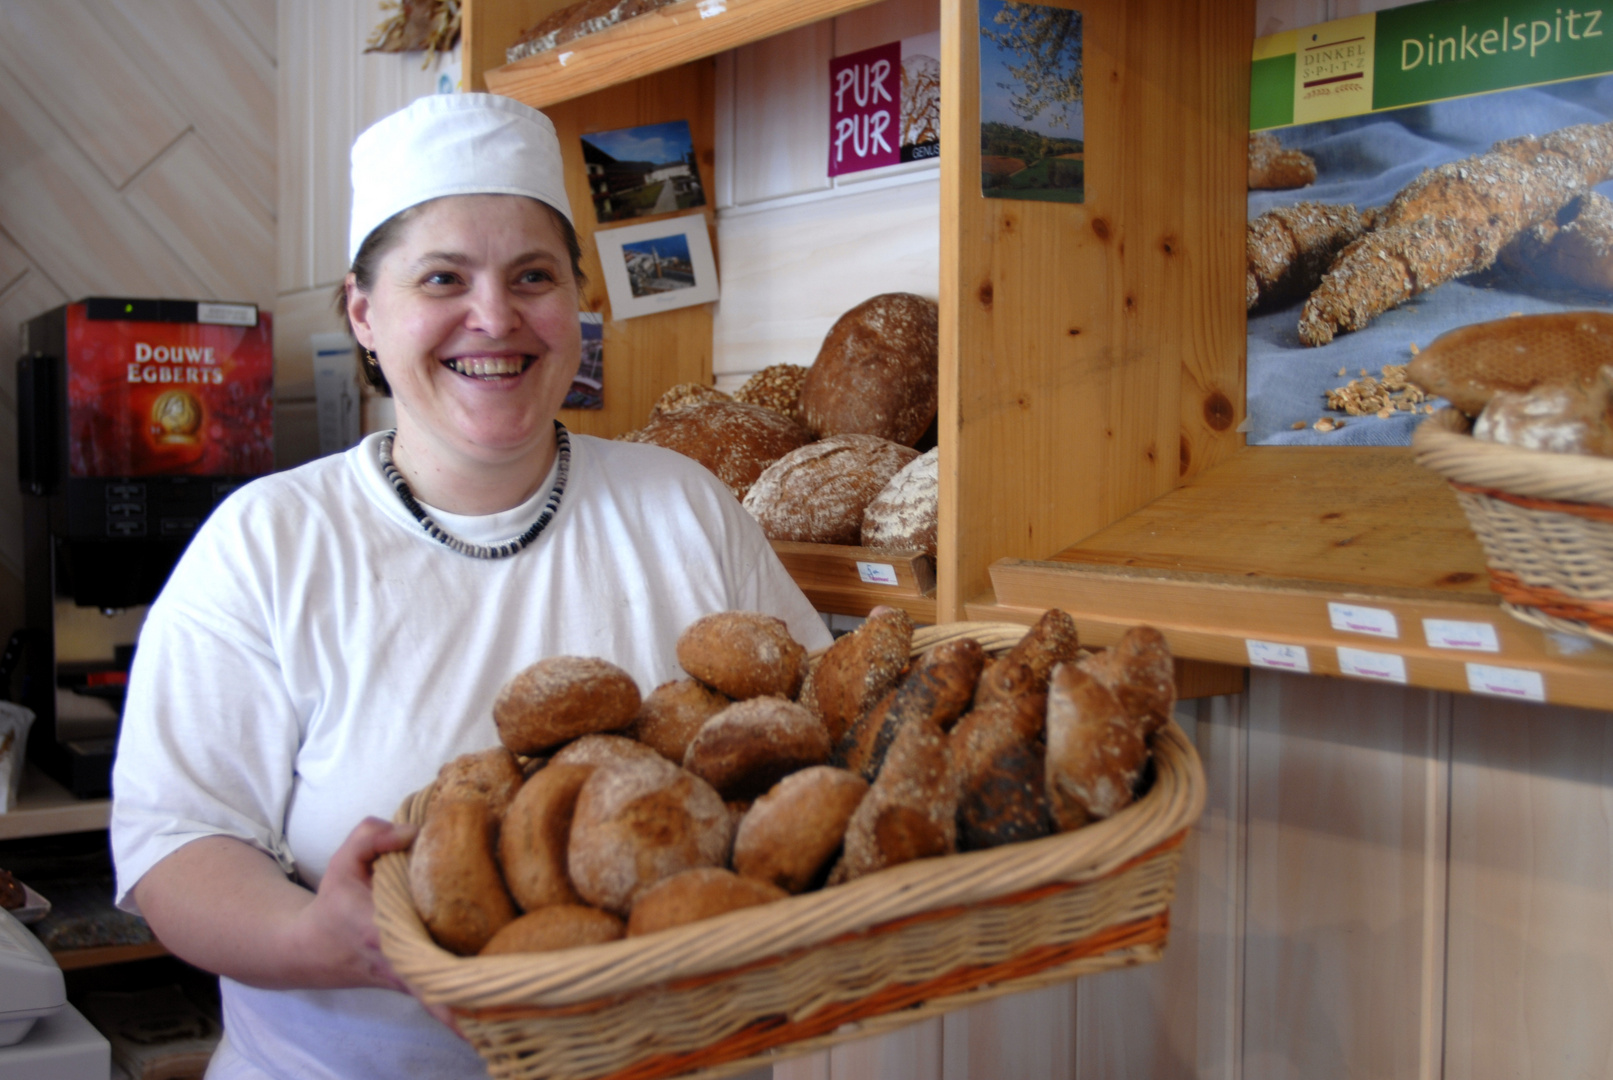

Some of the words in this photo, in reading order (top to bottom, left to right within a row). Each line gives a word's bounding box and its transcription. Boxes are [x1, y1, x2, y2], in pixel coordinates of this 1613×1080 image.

[1304, 44, 1365, 66] DINKEL
[1401, 8, 1603, 71] Dinkelspitz
[834, 59, 892, 113] PUR
[834, 110, 892, 162] PUR
[135, 342, 216, 365] DOUWE
[127, 363, 223, 385] EGBERTS
